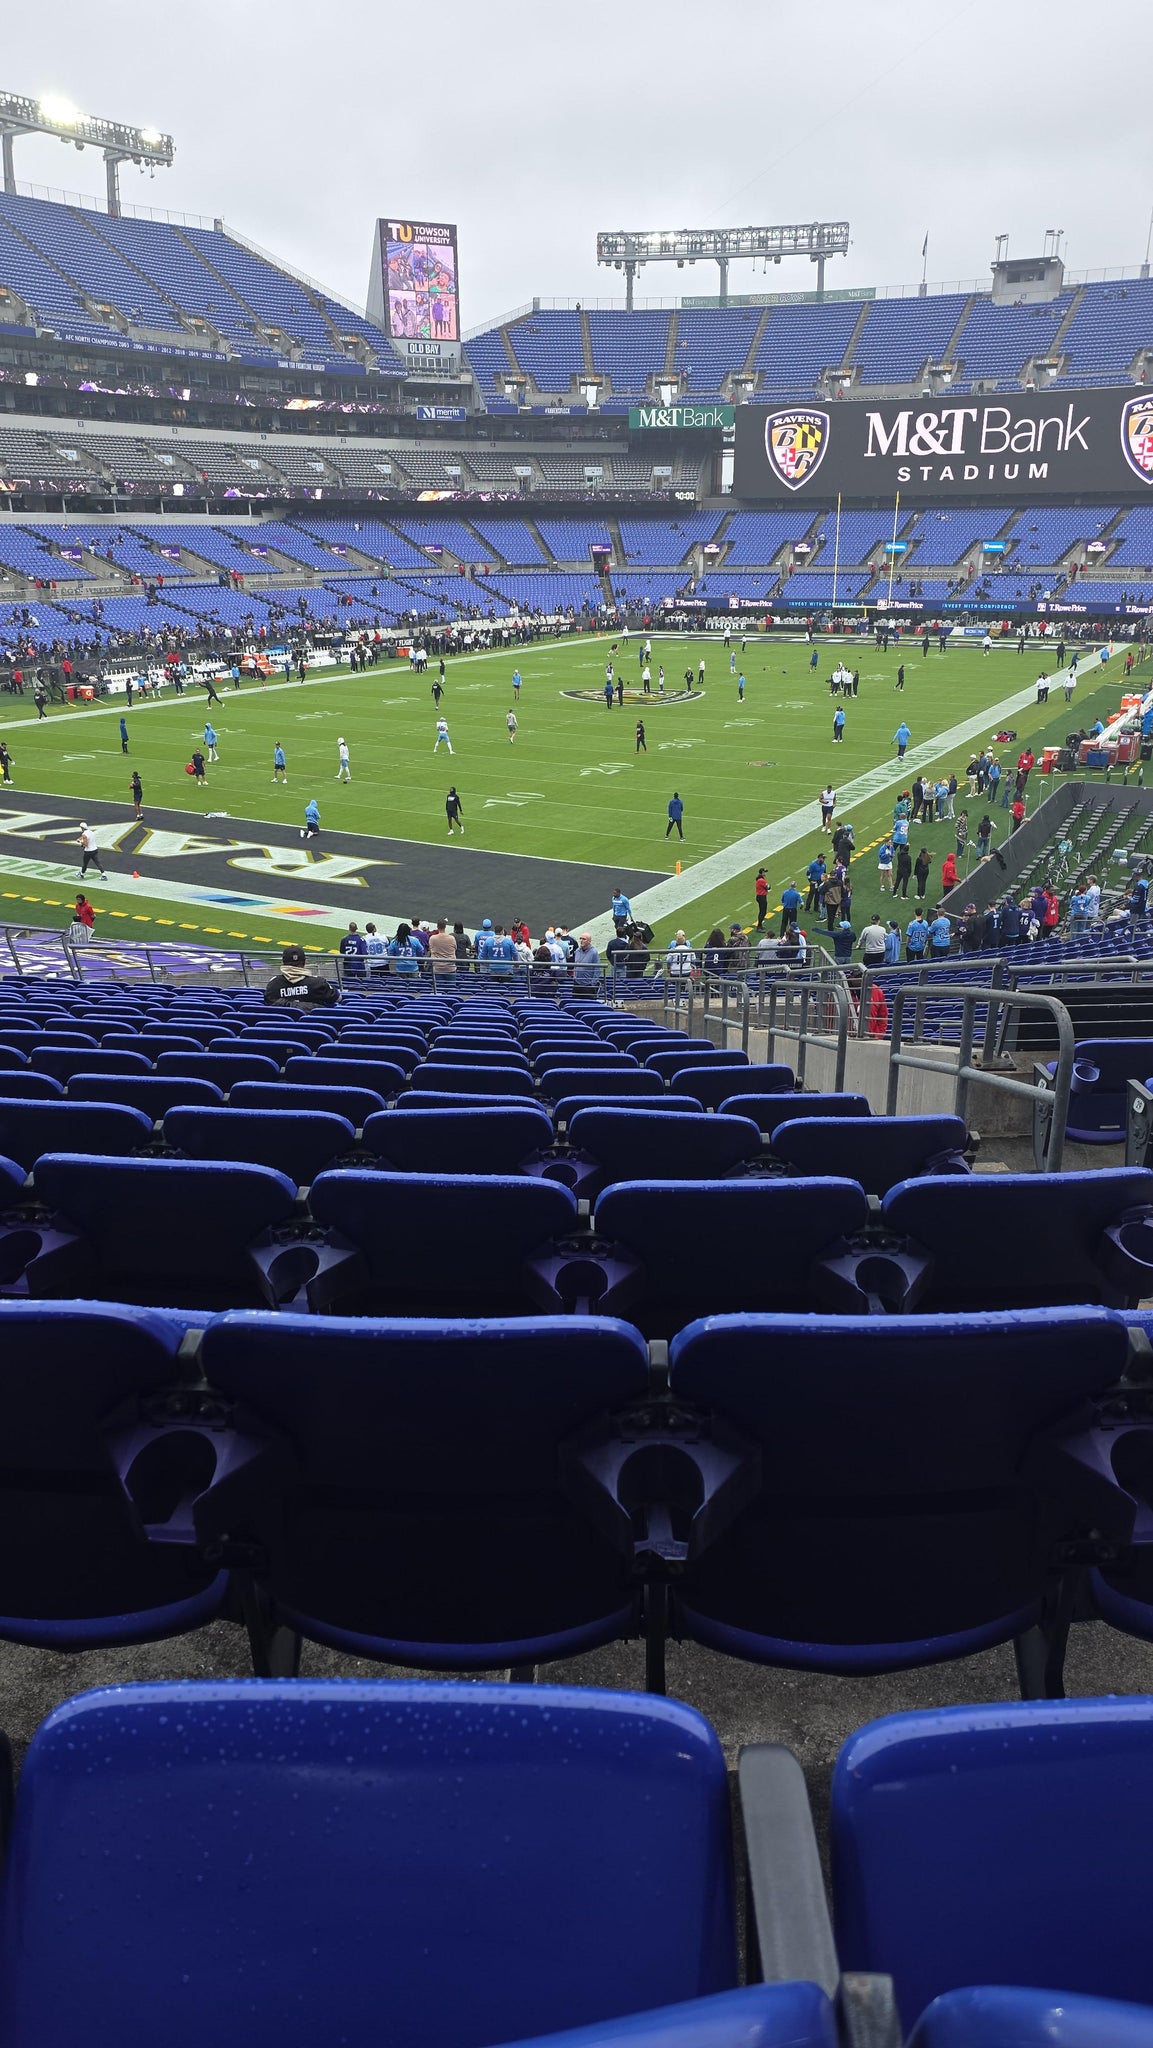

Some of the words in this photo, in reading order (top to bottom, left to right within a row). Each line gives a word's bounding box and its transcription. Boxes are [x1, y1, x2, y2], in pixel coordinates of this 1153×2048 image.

[388, 222, 412, 242] TU
[413, 226, 450, 237] TOWSON
[414, 235, 450, 244] UNIVERSITY
[91, 337, 118, 347] CHAMPIONS
[410, 343, 424, 353] OLD
[425, 344, 439, 354] BAY
[436, 408, 460, 417] merritt
[639, 408, 682, 427] M&T
[683, 408, 724, 427] Bank
[773, 415, 822, 431] RAVENS
[864, 408, 978, 457] M&T
[980, 404, 1091, 453] Bank
[897, 463, 1049, 482] STADIUM
[579, 762, 635, 777] 20
[482, 791, 546, 808] 10
[399, 947, 413, 957] 73
[492, 947, 505, 957] 71
[280, 985, 308, 998] FLOWERS
